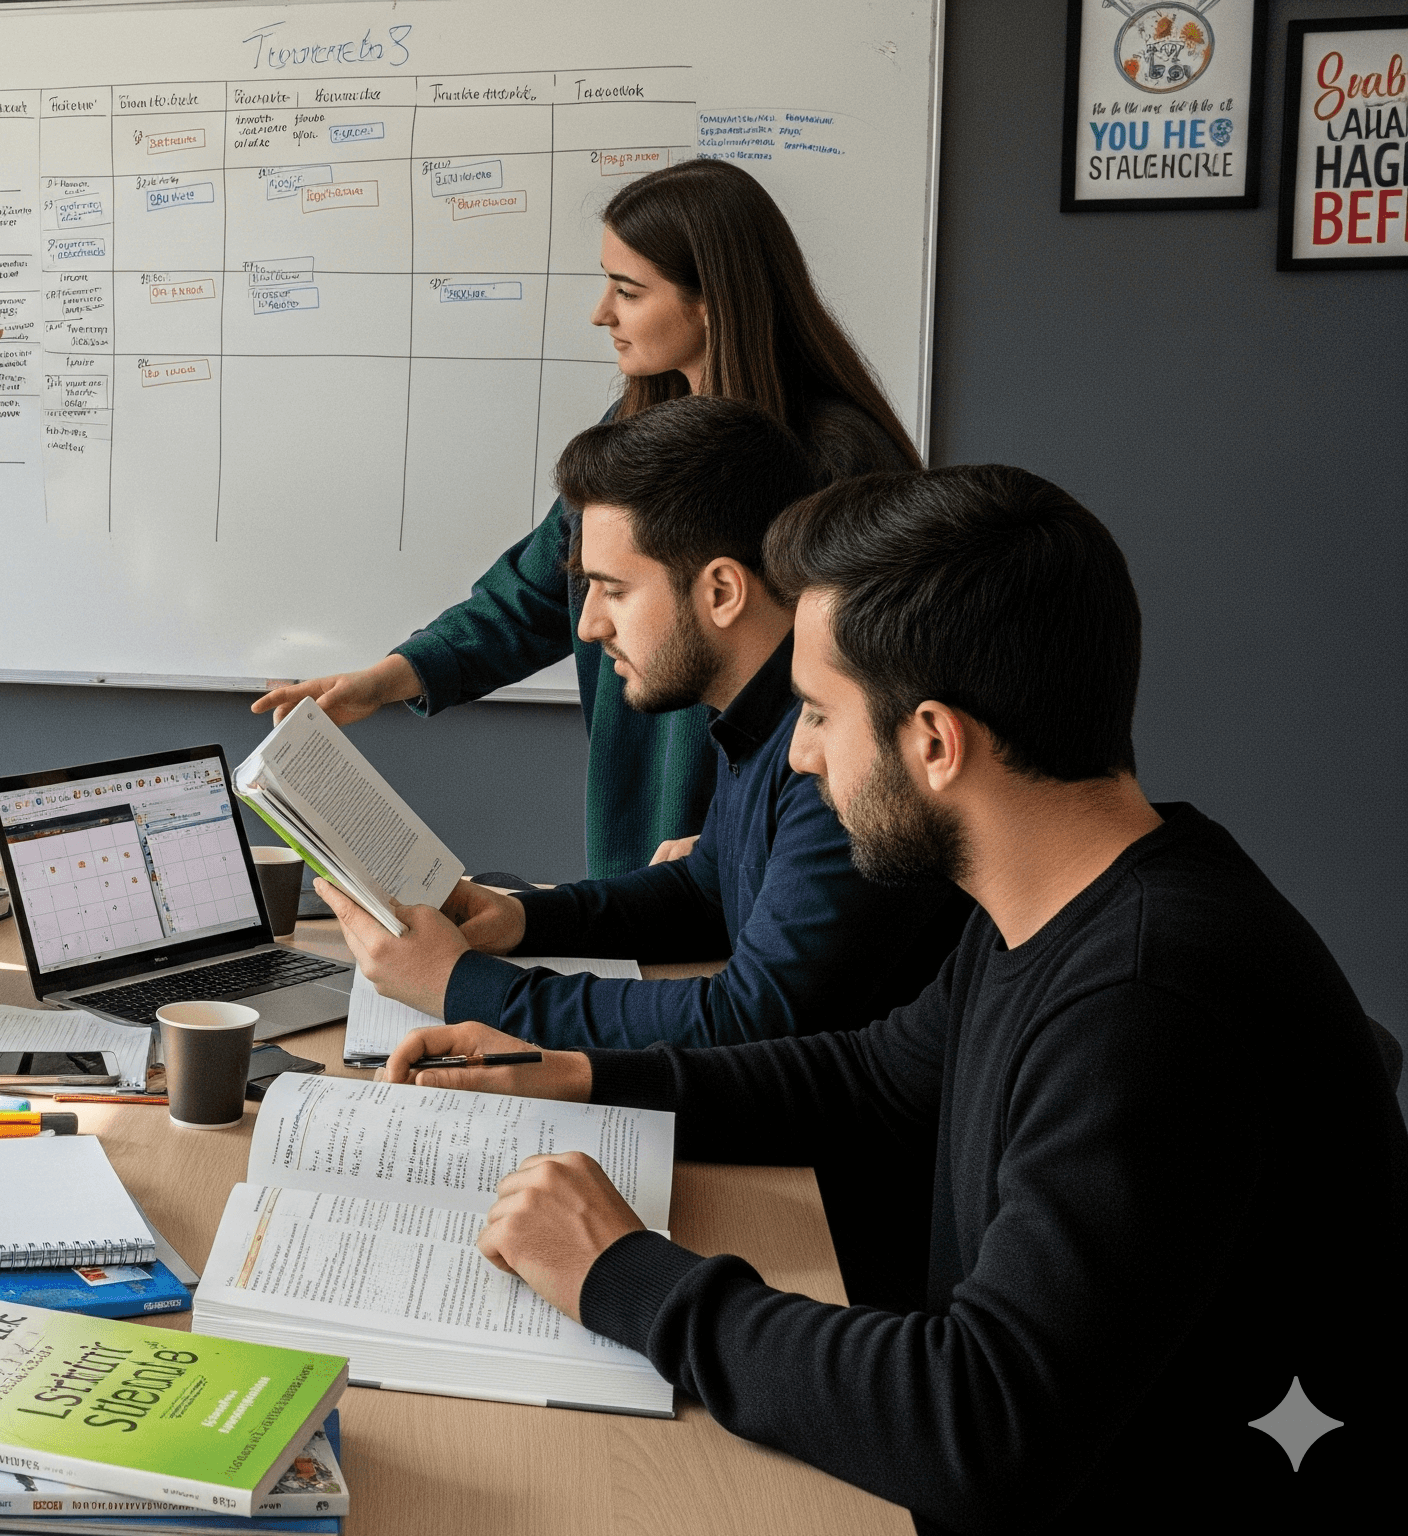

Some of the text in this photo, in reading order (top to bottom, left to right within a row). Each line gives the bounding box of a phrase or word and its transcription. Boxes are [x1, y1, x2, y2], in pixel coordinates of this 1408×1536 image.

[1089, 121, 1149, 151] YOU
[1315, 142, 1408, 189] HAG
[1312, 189, 1408, 245] BEF
